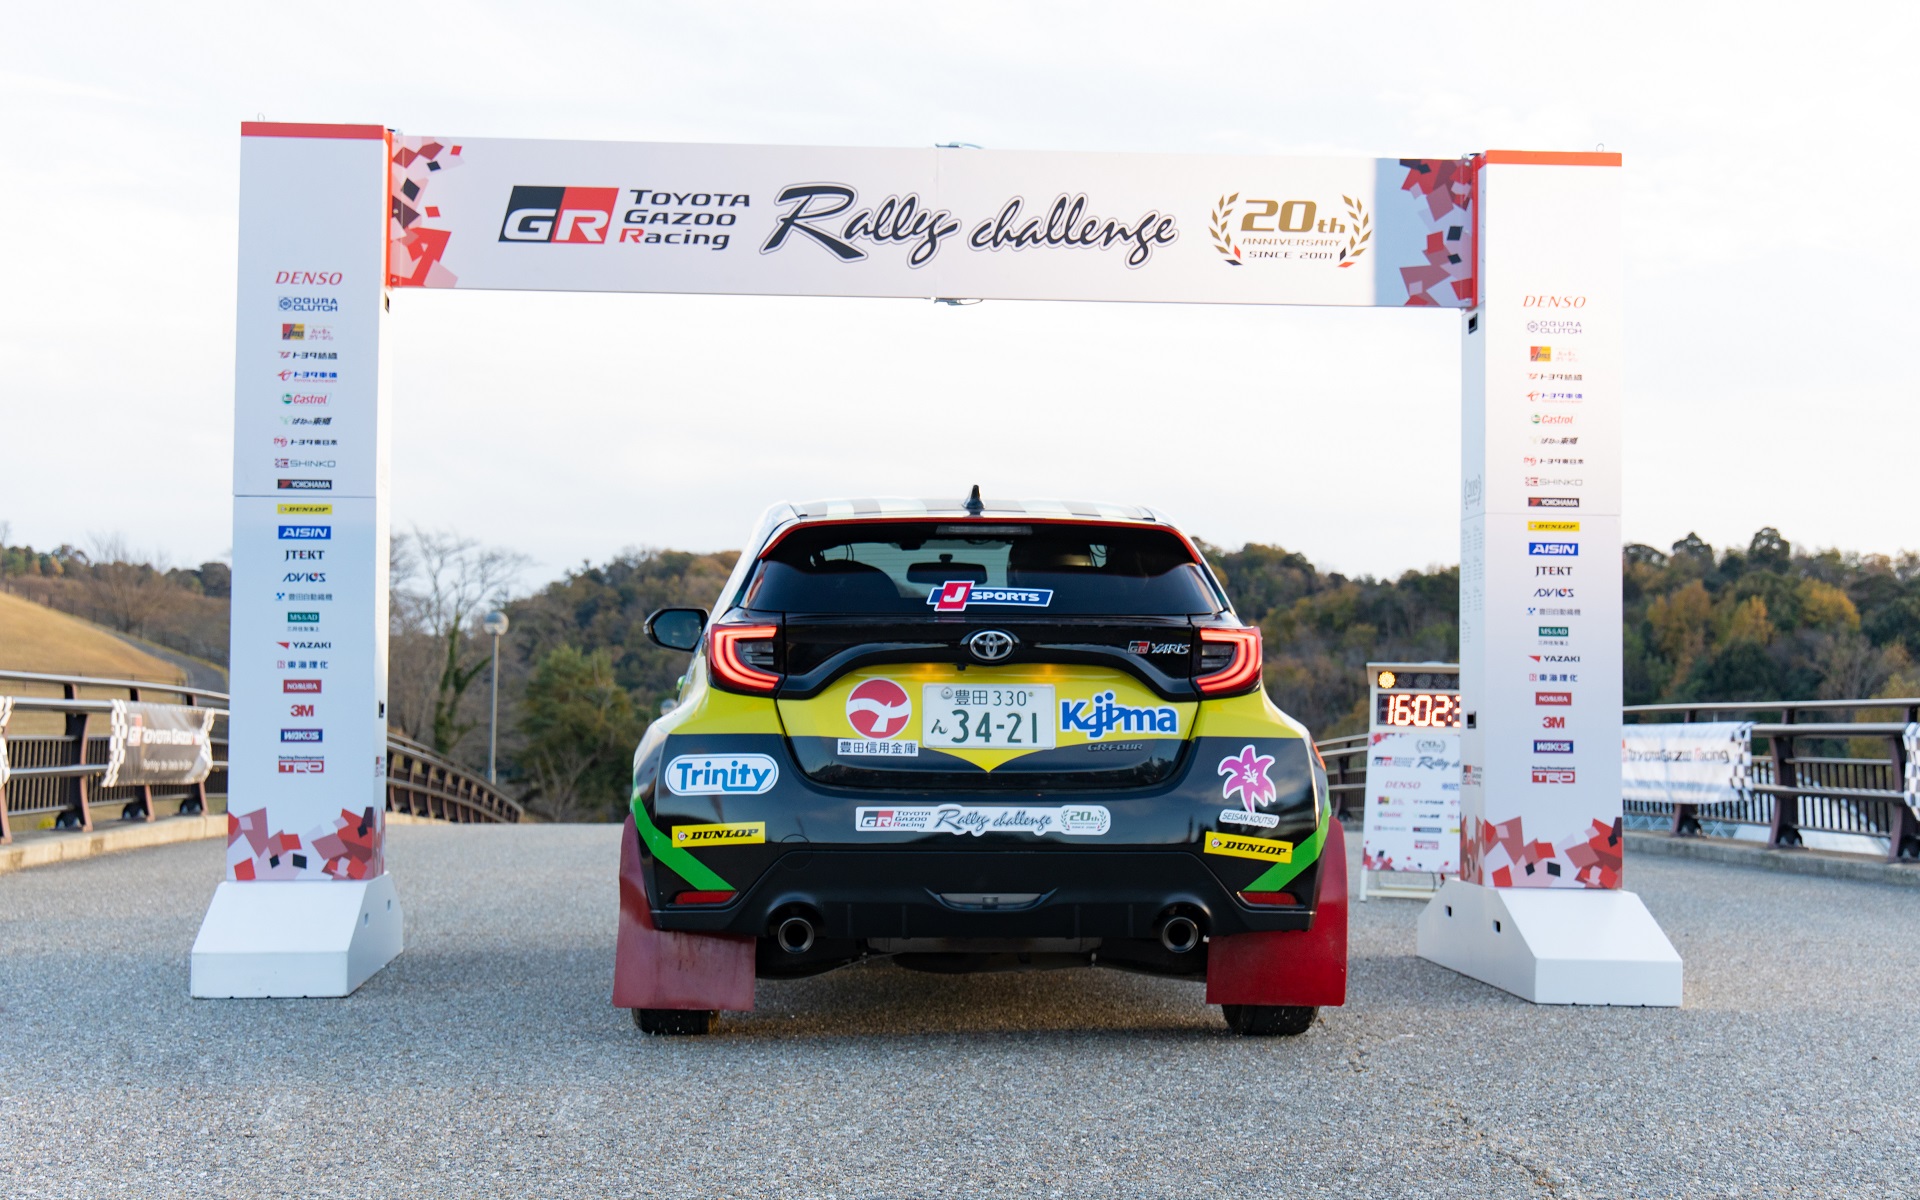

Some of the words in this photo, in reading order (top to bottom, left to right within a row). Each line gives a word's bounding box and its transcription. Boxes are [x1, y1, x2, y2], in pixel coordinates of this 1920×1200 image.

[630, 189, 750, 208] TOYOTA
[623, 209, 737, 226] GAZOO
[1241, 200, 1345, 233] 20th
[504, 208, 611, 242] GR
[762, 184, 960, 266] Rally
[970, 193, 1178, 265] challenge
[619, 228, 730, 251] Racing
[1242, 238, 1341, 246] ANNIVERSARY
[1249, 251, 1292, 259] SINCE
[275, 271, 343, 285] DENSO
[1523, 295, 1586, 308] DENSO
[294, 394, 327, 404] Castrol
[1541, 415, 1573, 424] Castrol
[290, 460, 336, 468] SHINKO
[283, 528, 327, 537] AISIN
[1533, 544, 1575, 554] AISIN
[285, 550, 325, 561] JTEKT
[1536, 566, 1573, 576] JTEKT
[283, 573, 326, 582] ADVICS
[943, 586, 965, 602] J
[971, 591, 1040, 602] SPORTS
[1534, 588, 1574, 597] ADVICS
[1129, 644, 1149, 654] GR
[1151, 643, 1190, 655] YARIS
[954, 689, 988, 706] 豊田
[993, 690, 1027, 706] 330
[290, 705, 314, 717] 3M
[930, 719, 948, 736] ん
[951, 709, 1037, 744] 34-21
[1543, 717, 1565, 728] 3M
[840, 741, 916, 755] 豊田信用金庫
[280, 762, 322, 773] TRD
[677, 761, 771, 791] Trinity
[1534, 772, 1574, 783] TRD
[1385, 781, 1421, 789] DENSO
[862, 816, 892, 828] GR
[934, 809, 990, 831] Rally
[993, 810, 1052, 831] challenge
[1070, 811, 1100, 822] 20th
[1222, 812, 1248, 821] SEISAN
[1250, 814, 1277, 825] KOUTSU
[691, 828, 759, 840] DUNLOP
[1224, 841, 1287, 856] DUNLOP
